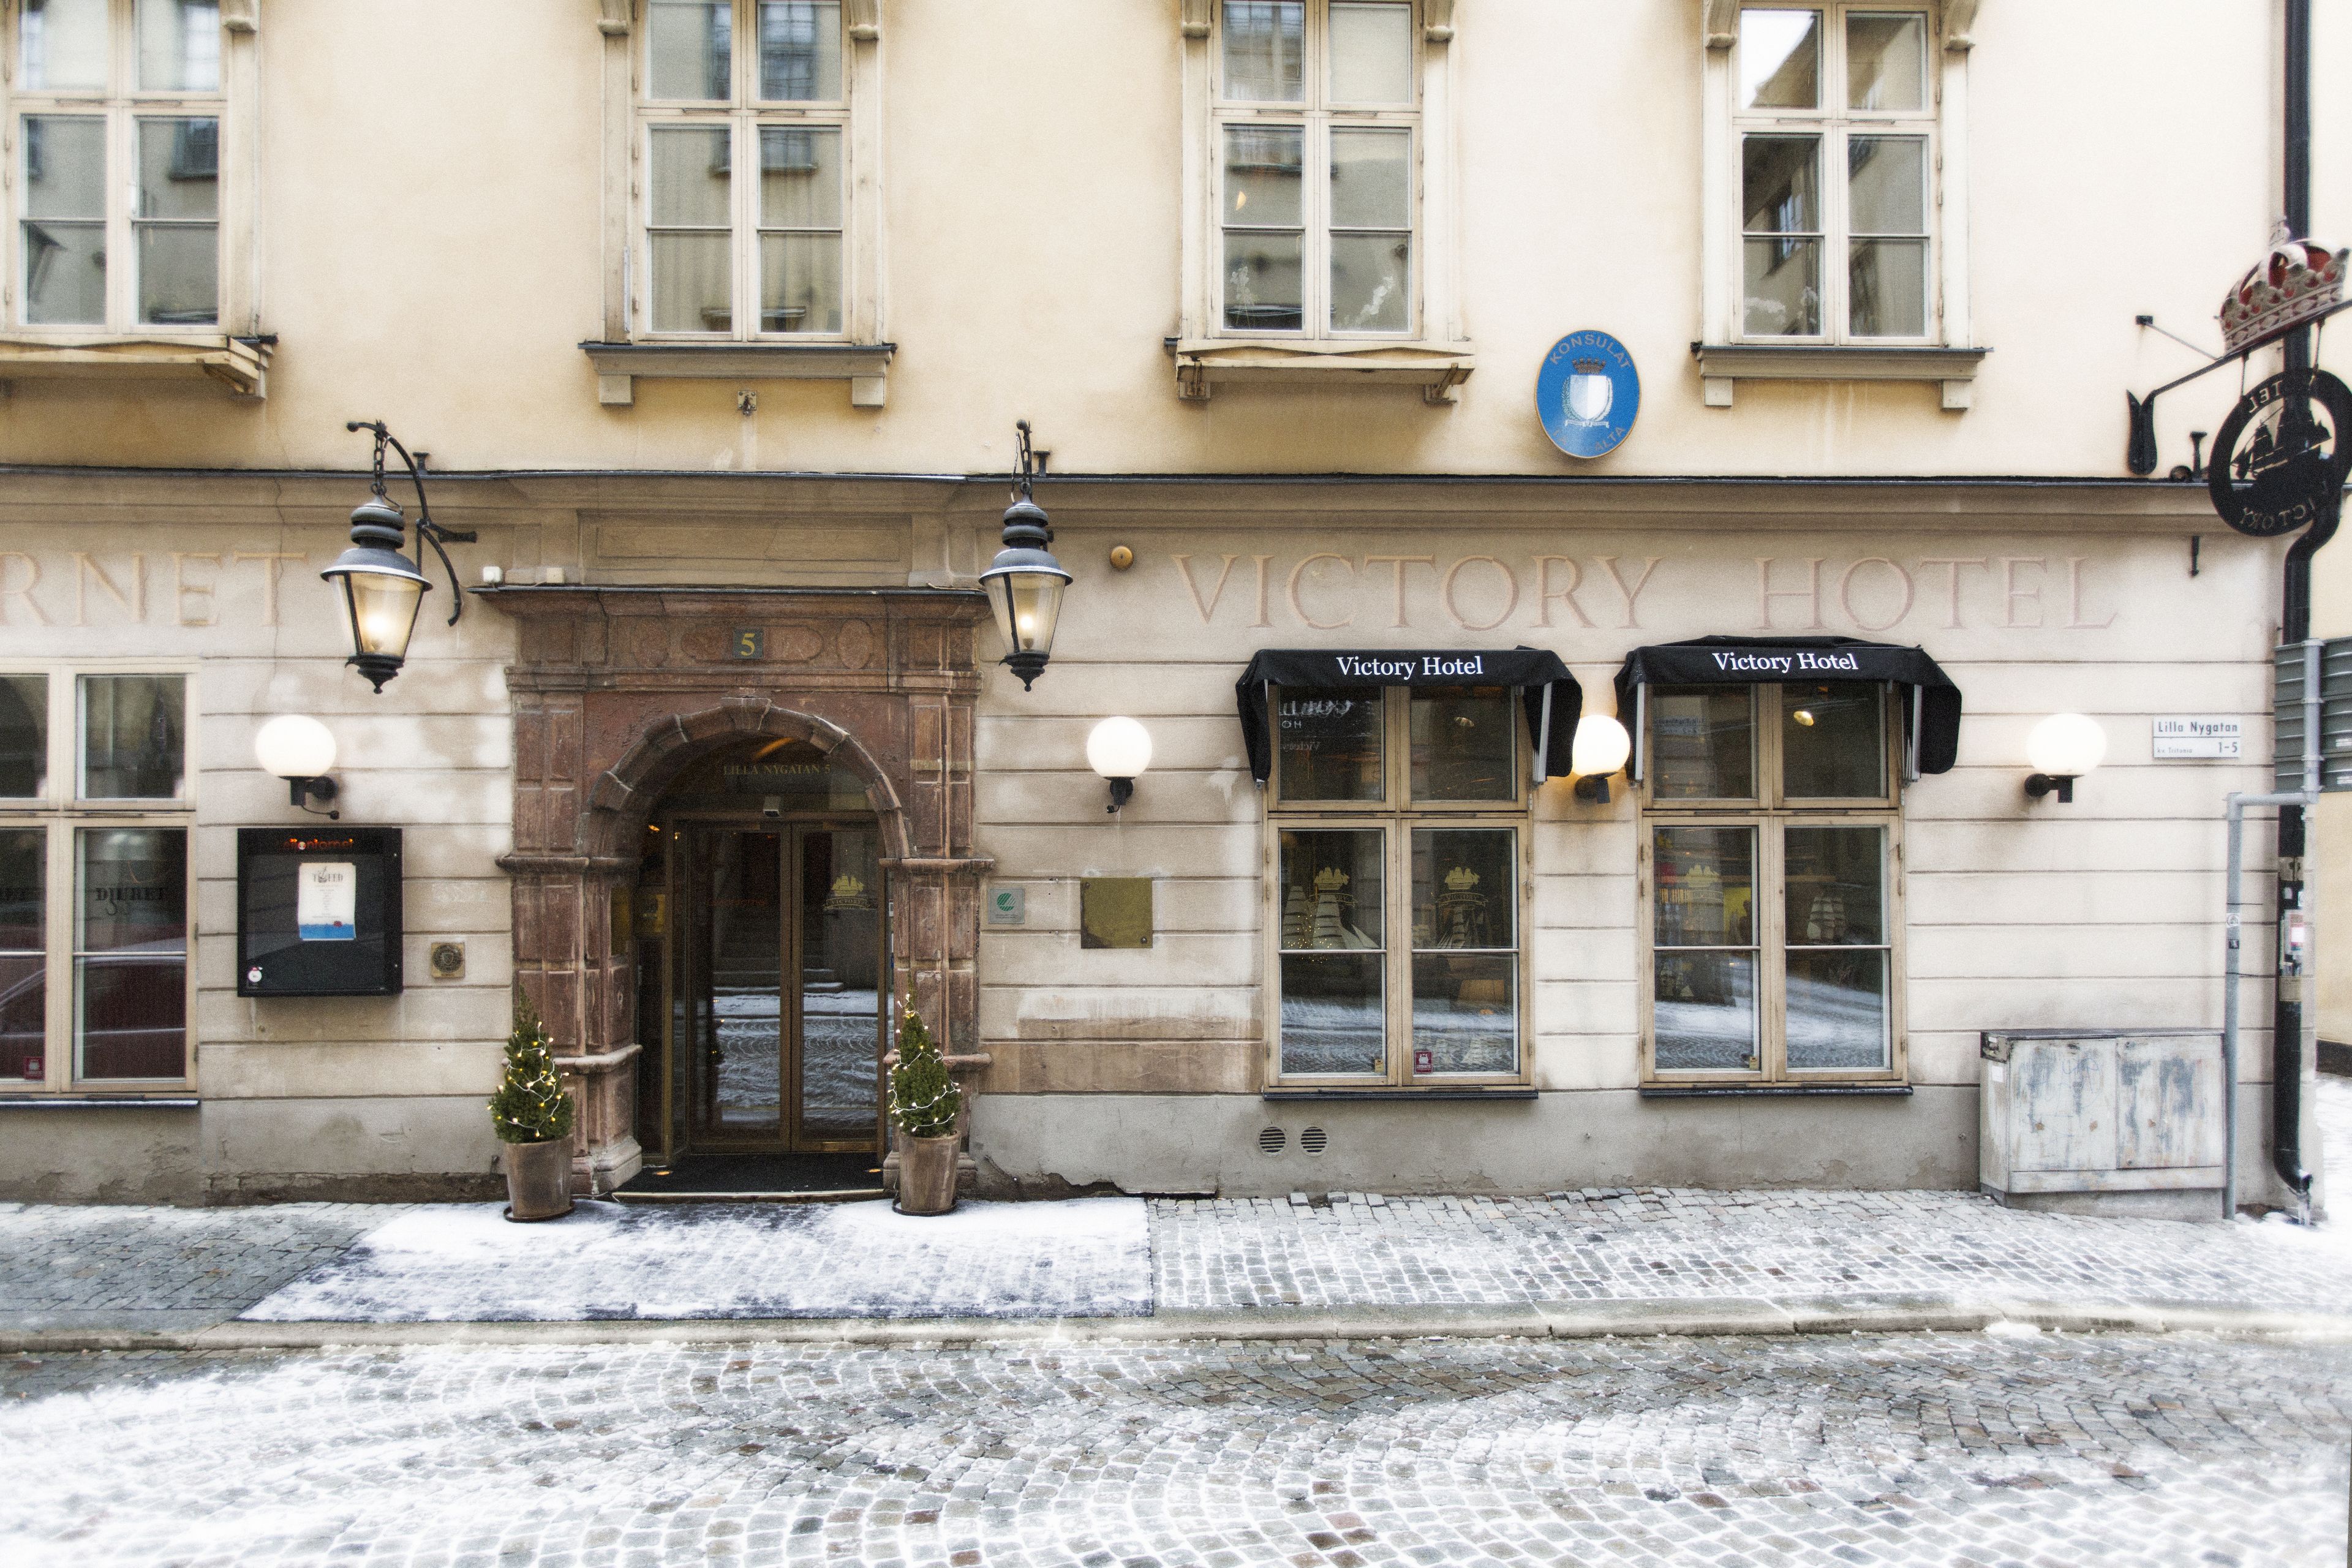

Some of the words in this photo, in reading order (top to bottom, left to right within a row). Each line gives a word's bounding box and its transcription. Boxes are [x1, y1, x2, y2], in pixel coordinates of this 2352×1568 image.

[1550, 334, 1631, 369] KONSULAT
[1170, 552, 1666, 631] VICTORY
[1750, 557, 2120, 631] HOTEL
[741, 633, 755, 657] 5
[1336, 656, 1416, 680] Victory
[1423, 655, 1483, 676] Hotel
[1712, 652, 1792, 673] Victory
[1798, 653, 1859, 671] Hotel
[2158, 722, 2184, 732] Lilla
[2190, 722, 2238, 735] Nygatan
[2218, 742, 2238, 753] 1-5
[723, 764, 759, 775] LILLA
[764, 764, 820, 775] NYGATAN
[824, 764, 831, 774] 5
